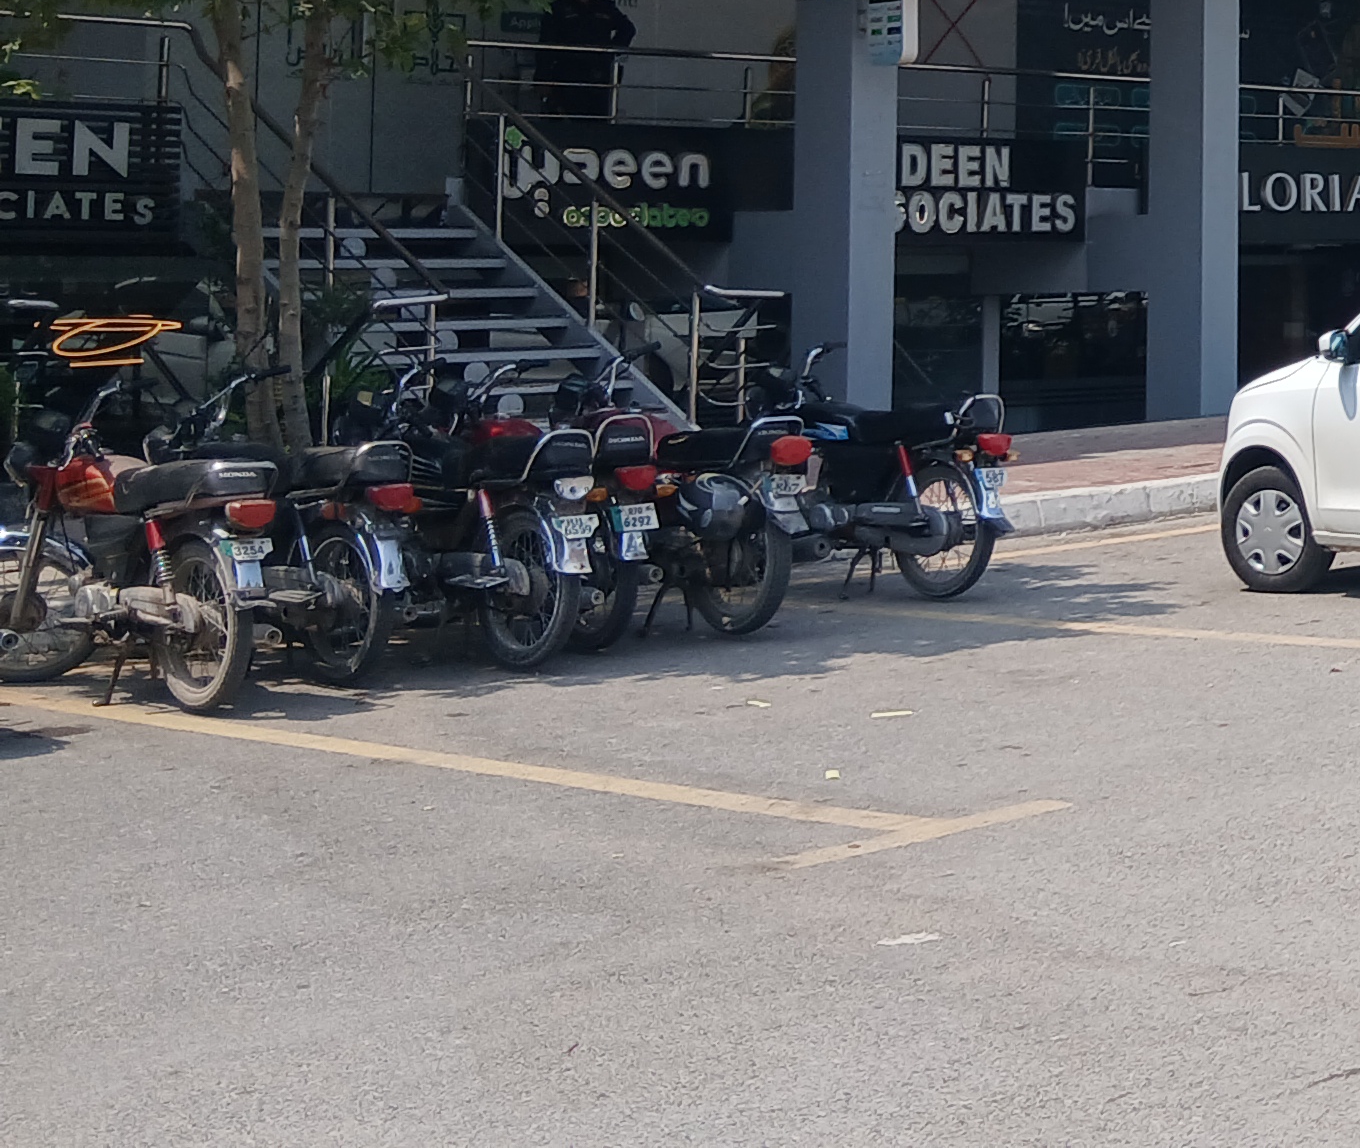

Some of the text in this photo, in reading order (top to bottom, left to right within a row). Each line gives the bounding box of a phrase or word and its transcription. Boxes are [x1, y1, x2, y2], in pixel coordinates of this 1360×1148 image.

[15, 117, 131, 179] EN
[901, 142, 1011, 188] DEEN
[623, 516, 651, 528] 6292
